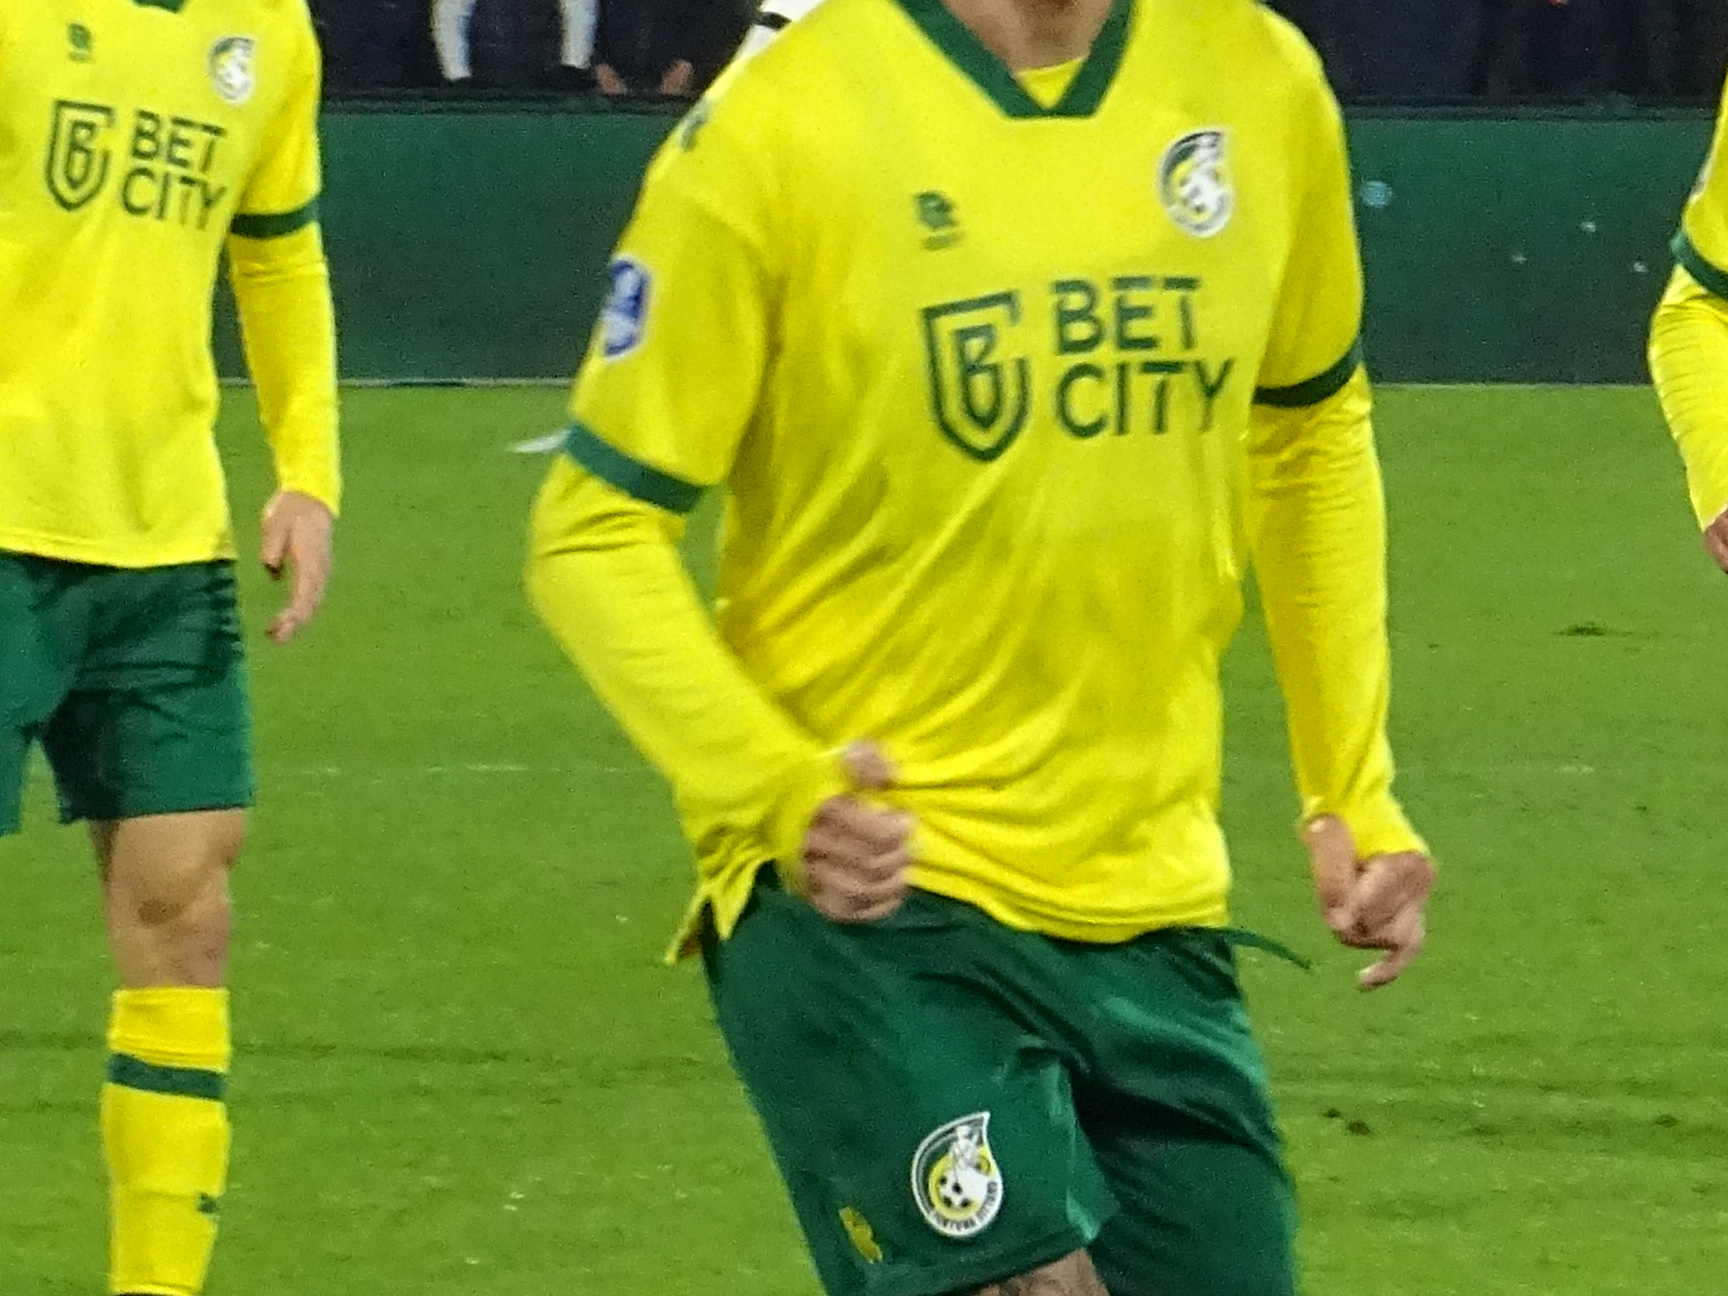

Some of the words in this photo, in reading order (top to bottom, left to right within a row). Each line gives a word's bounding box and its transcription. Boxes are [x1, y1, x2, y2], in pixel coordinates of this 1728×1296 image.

[132, 109, 227, 172] BET
[120, 166, 227, 231] CITY
[1050, 275, 1201, 354] BET
[1053, 356, 1236, 439] CITY
